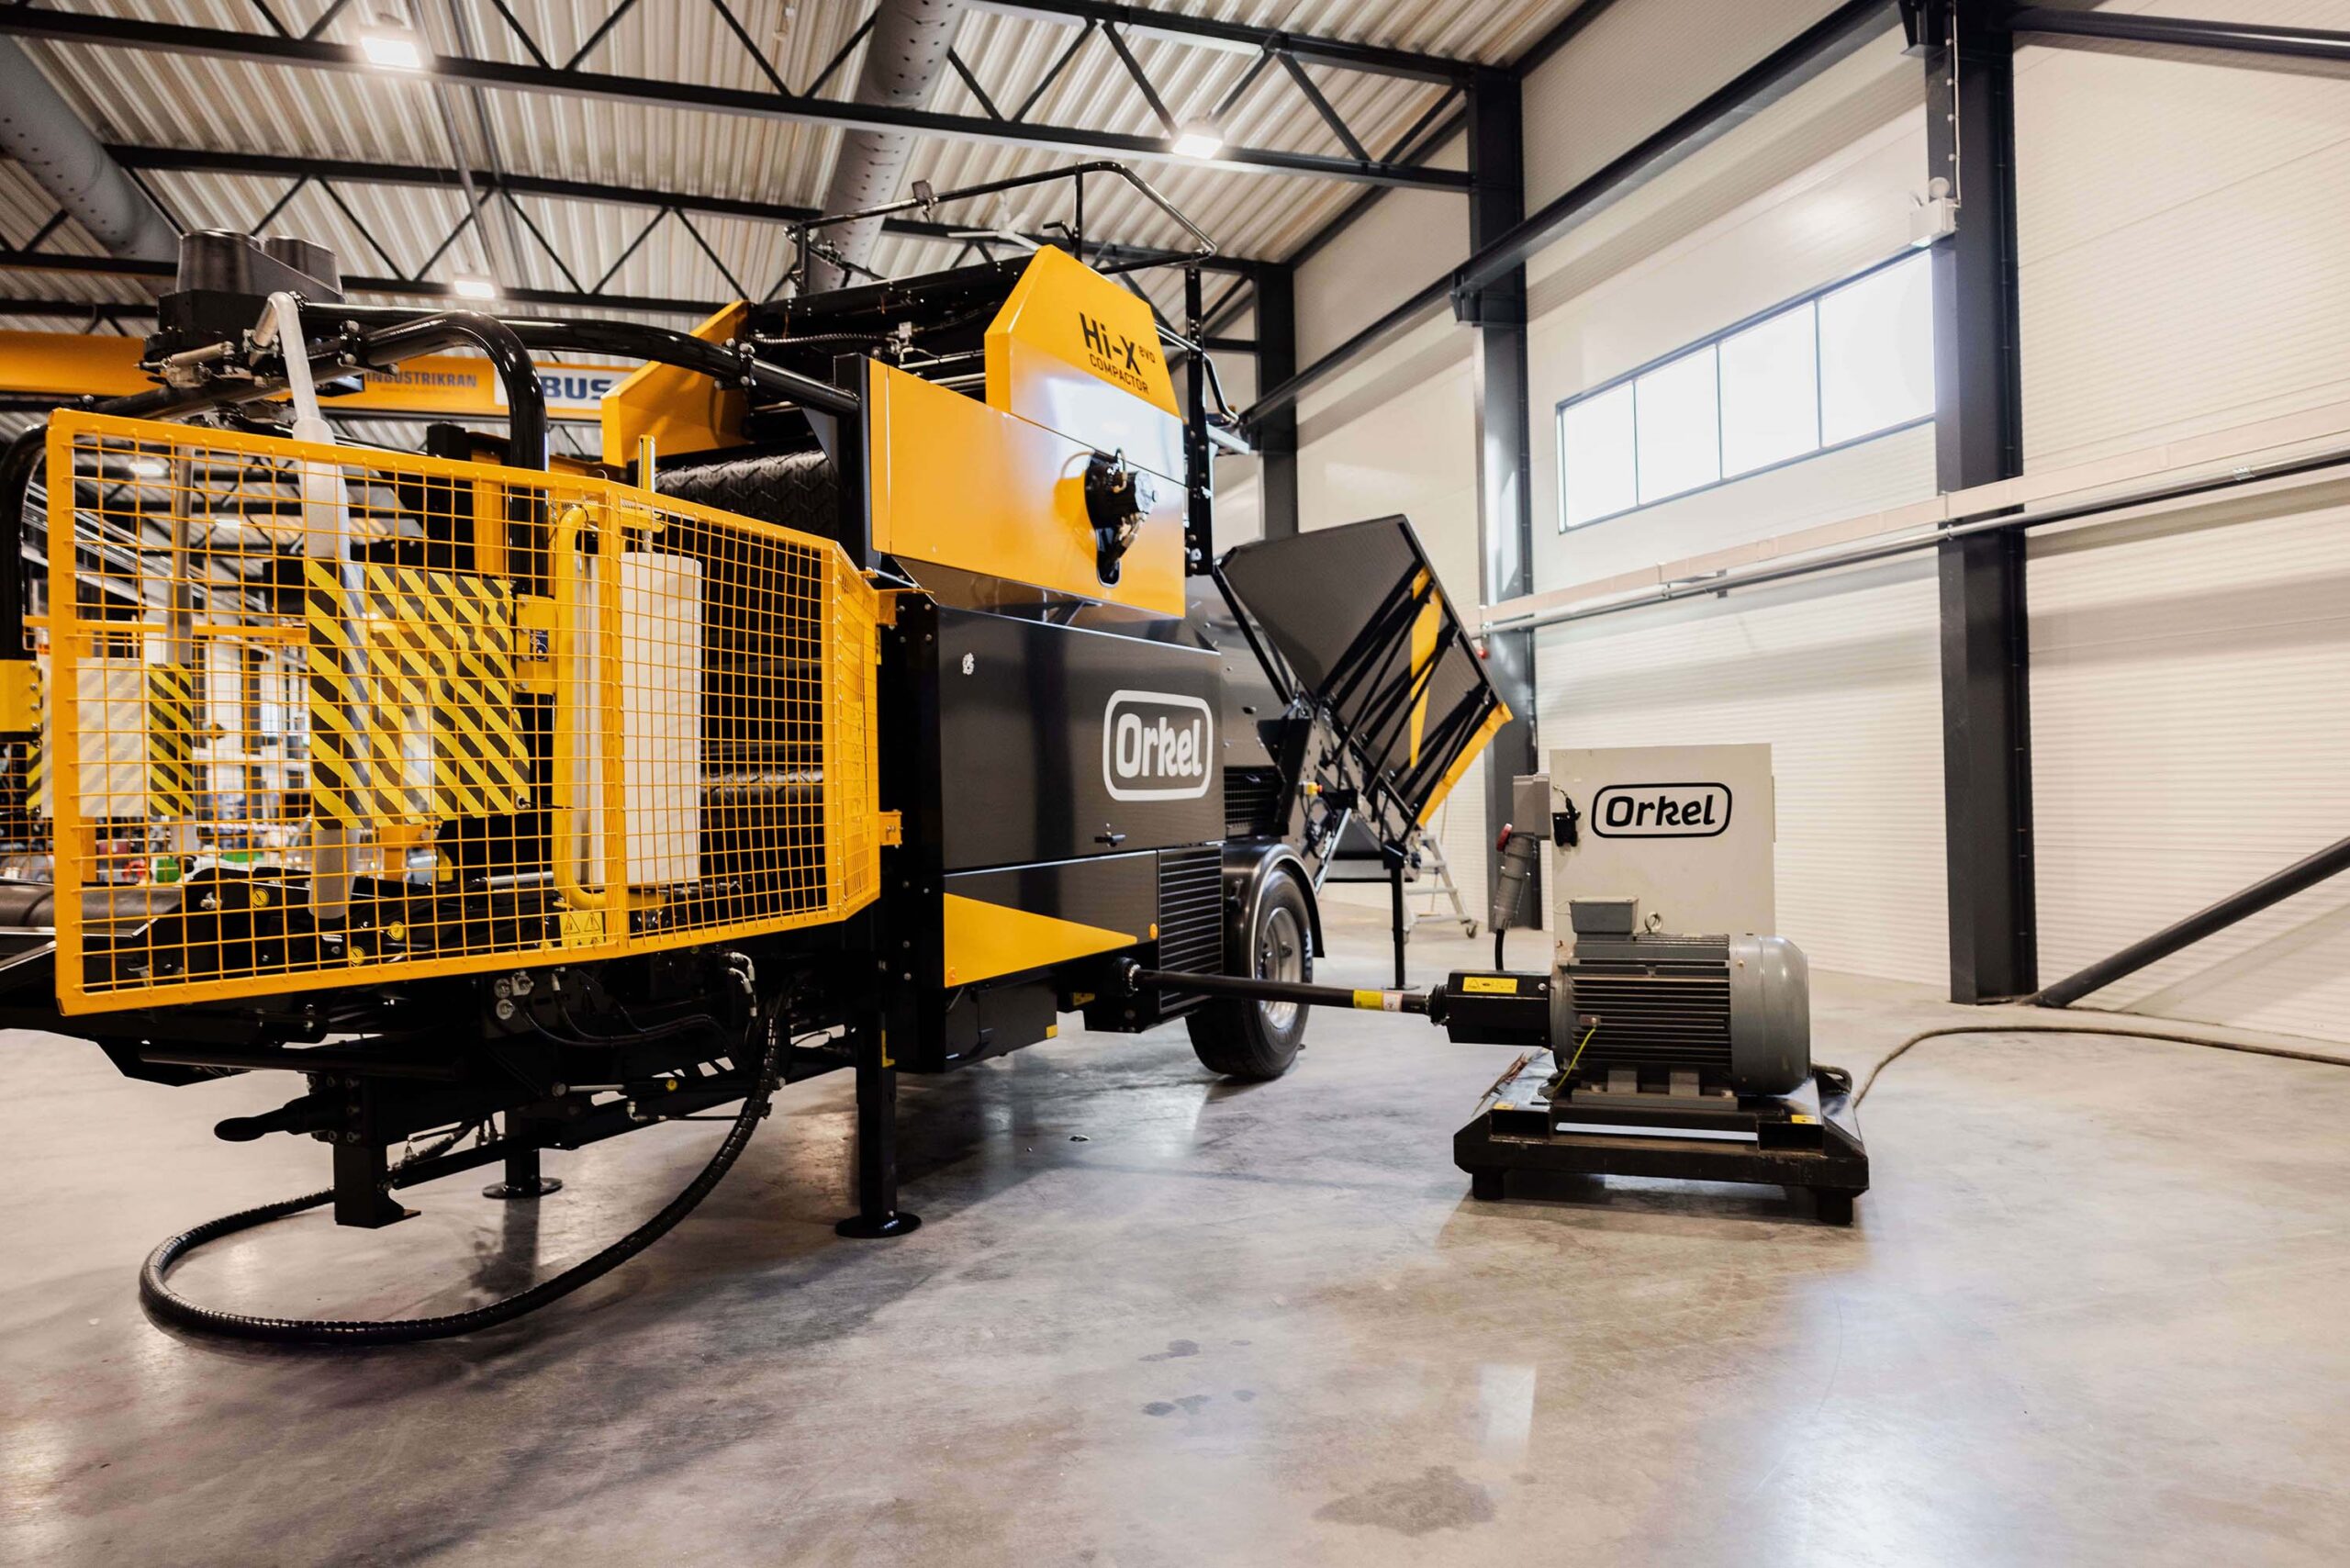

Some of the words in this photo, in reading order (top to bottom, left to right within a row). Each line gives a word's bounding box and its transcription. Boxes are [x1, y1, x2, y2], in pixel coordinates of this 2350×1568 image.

[1080, 311, 1142, 376] Hi-X
[1138, 345, 1156, 364] evo
[539, 375, 612, 399] BUS
[1089, 353, 1149, 395] COMPACTOR
[1116, 713, 1203, 778] Orkel
[1606, 794, 1716, 827] Orkel
